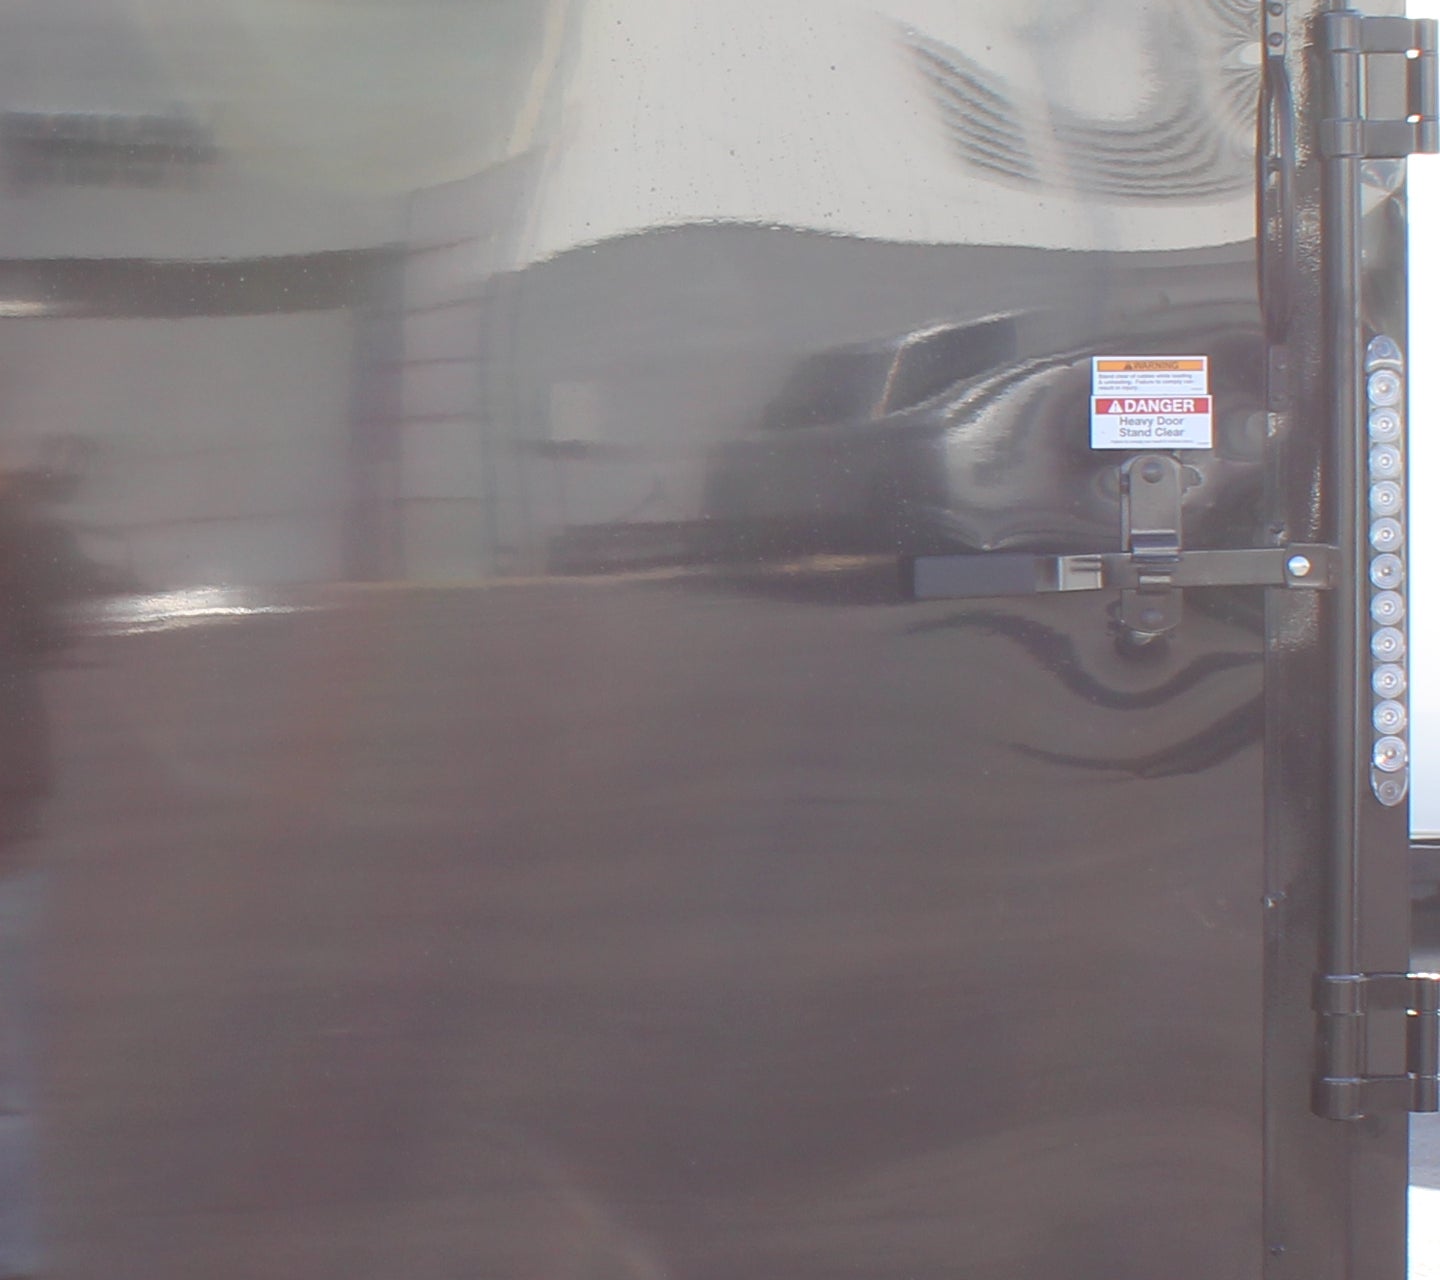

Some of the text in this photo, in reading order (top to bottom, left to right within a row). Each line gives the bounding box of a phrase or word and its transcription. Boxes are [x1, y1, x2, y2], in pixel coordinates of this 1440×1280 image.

[1124, 399, 1195, 413] DANGER
[1119, 416, 1184, 427] Heavy Door
[1119, 428, 1184, 437] Stand Clear
